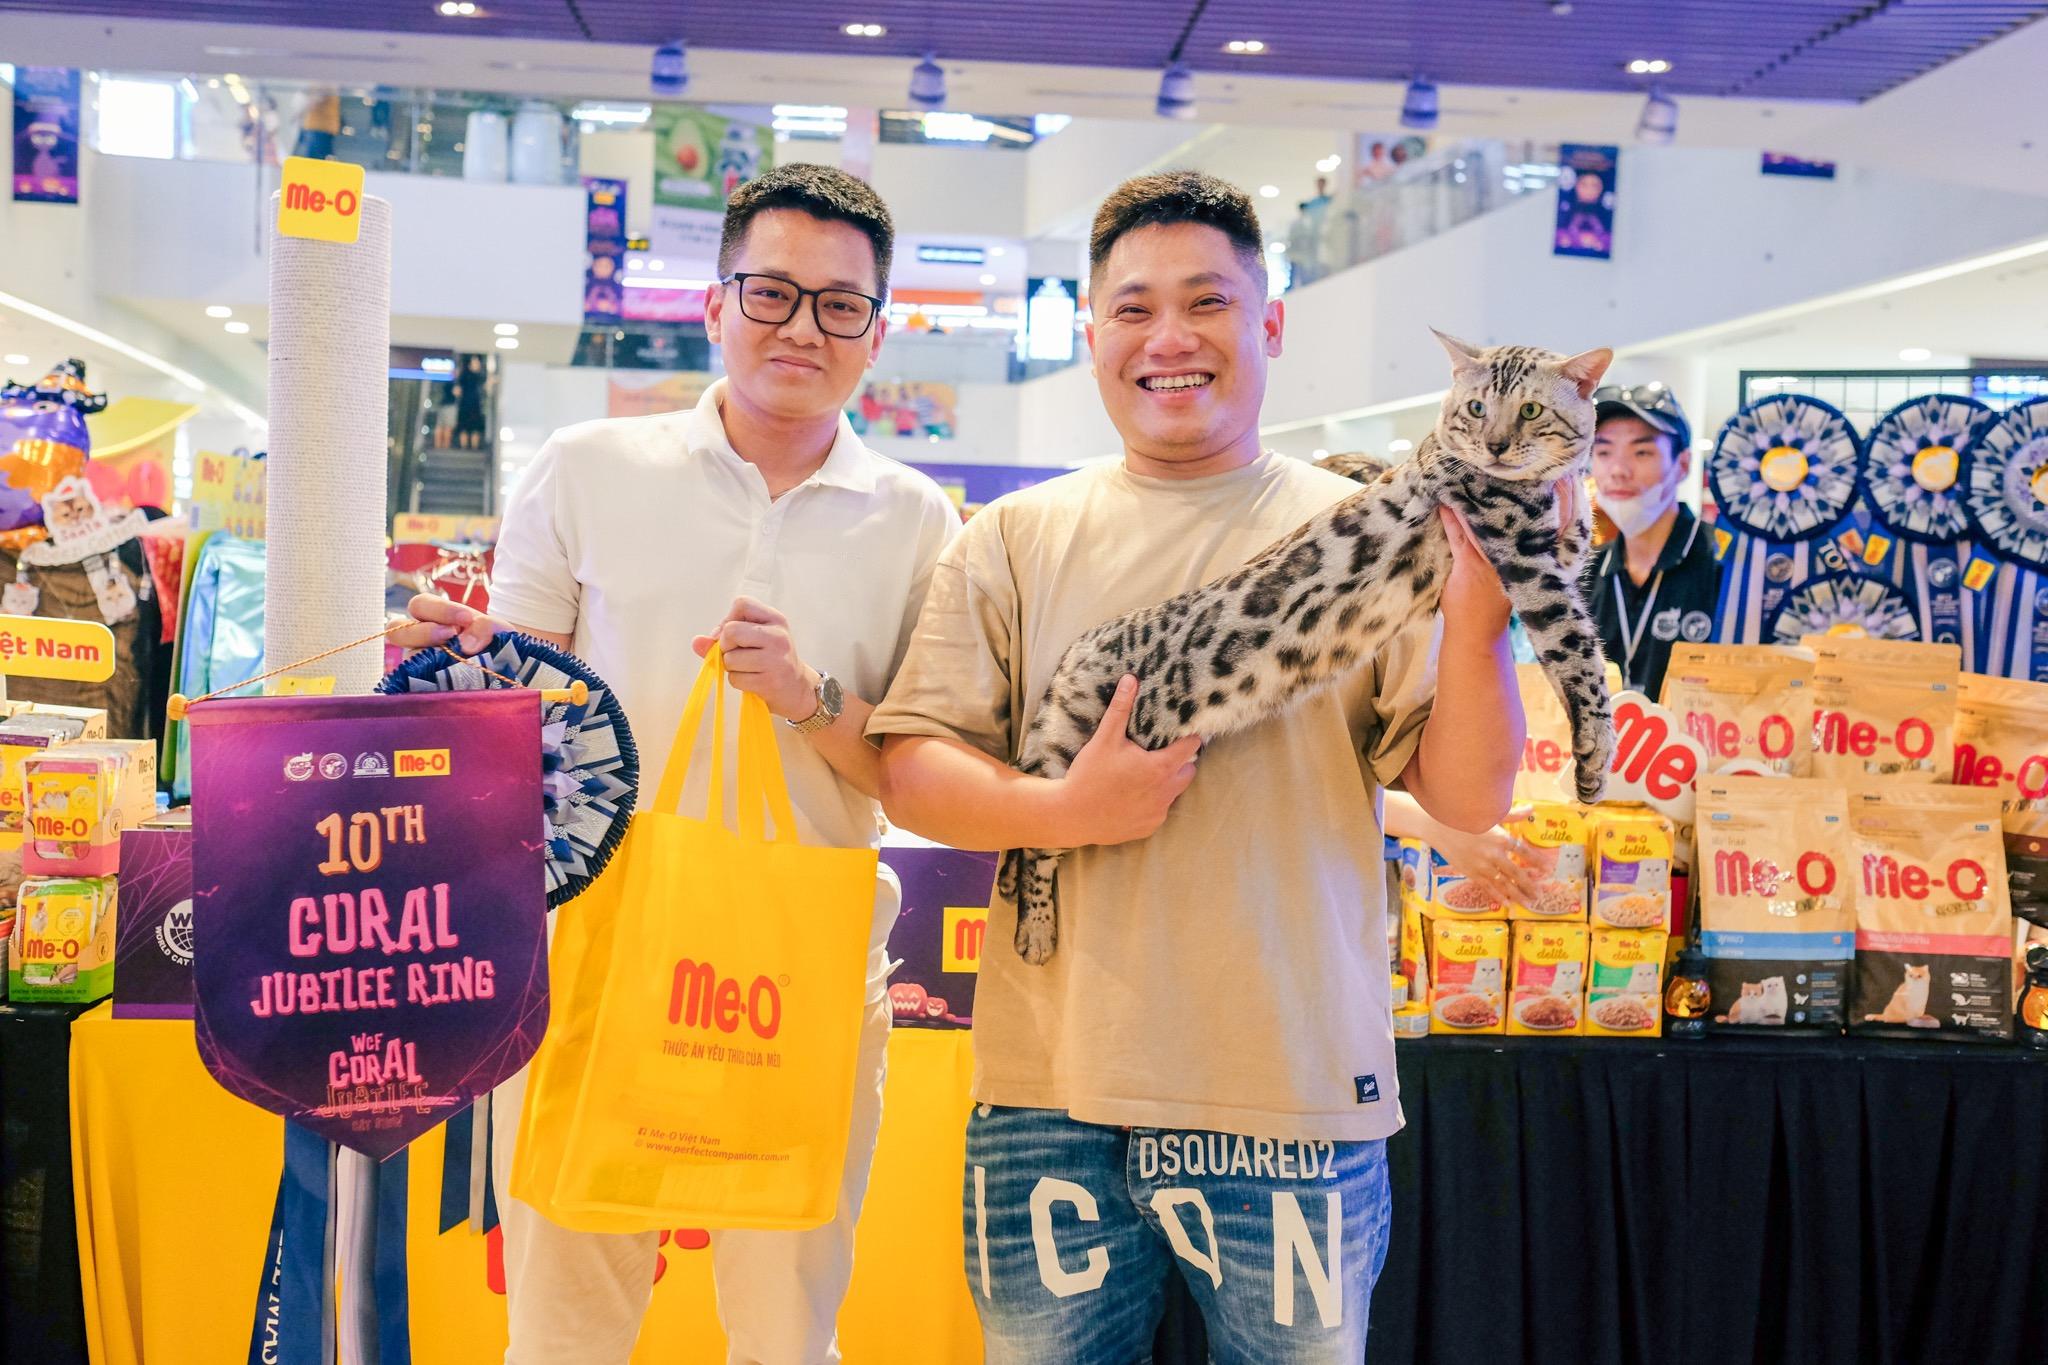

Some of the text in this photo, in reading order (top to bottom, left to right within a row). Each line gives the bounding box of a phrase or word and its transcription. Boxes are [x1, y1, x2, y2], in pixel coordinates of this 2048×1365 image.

[286, 183, 357, 216] Me-O
[0, 631, 99, 661] ệt Nam
[1519, 738, 1572, 773] e-
[1686, 711, 1794, 759] Me-O
[1812, 709, 1934, 760] Me-O
[400, 754, 446, 772] Me-O
[37, 816, 88, 837] Me-O
[316, 804, 427, 876] 10TH
[1715, 850, 1836, 897] Me-O
[1863, 853, 1988, 901] Me-O
[289, 883, 459, 957] CORAL
[27, 939, 79, 959] Me-O
[154, 925, 190, 967] WORLD CAT
[251, 956, 495, 1018] JUBILEE RING
[667, 958, 782, 1040] Me-O
[328, 1038, 424, 1089] CORAL
[352, 1032, 383, 1052] WCF
[700, 1135, 721, 1146] Nam
[1139, 1134, 1338, 1180] DSQUARED2
